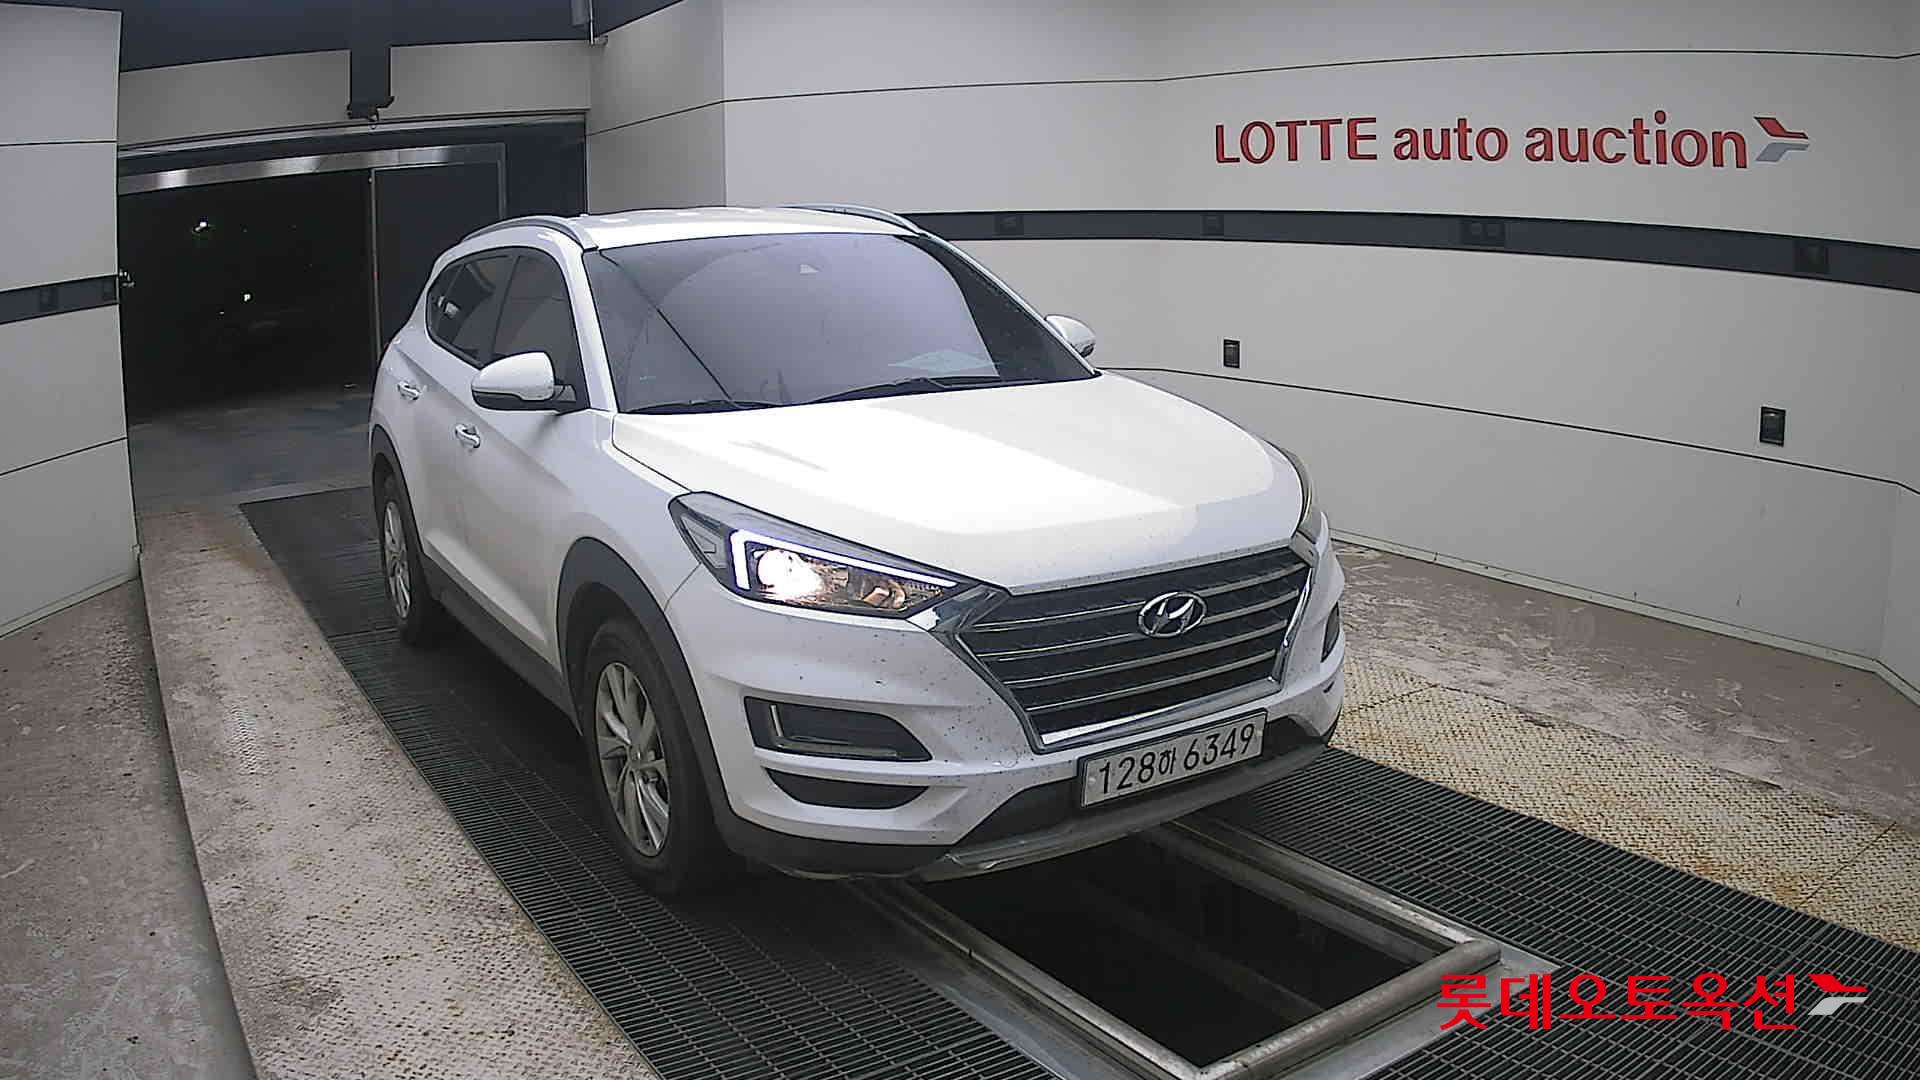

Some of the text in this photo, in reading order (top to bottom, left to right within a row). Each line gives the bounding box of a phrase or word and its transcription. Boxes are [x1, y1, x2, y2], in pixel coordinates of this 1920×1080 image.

[1215, 110, 1748, 169] LOTTE auto auction
